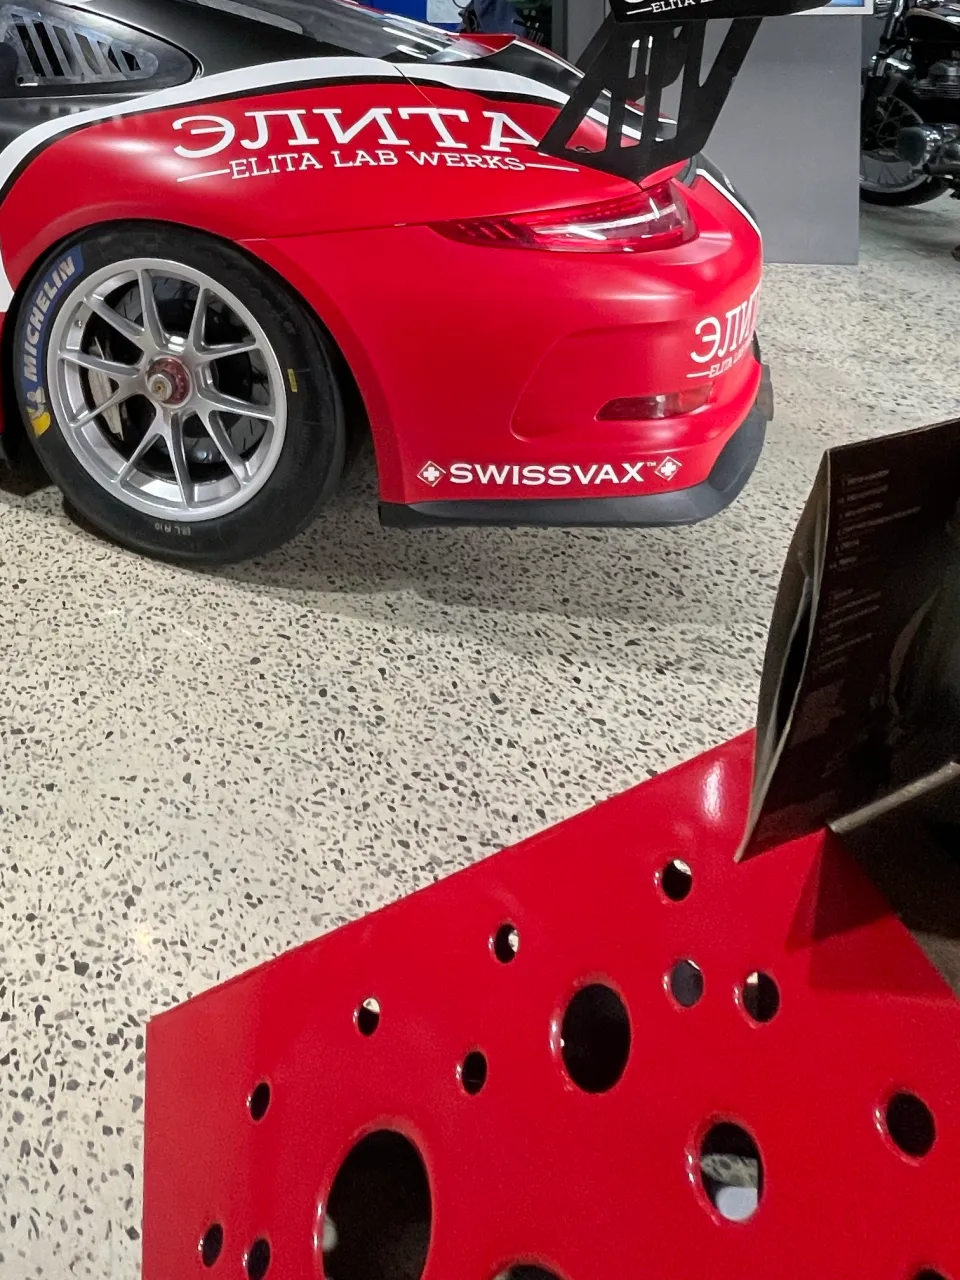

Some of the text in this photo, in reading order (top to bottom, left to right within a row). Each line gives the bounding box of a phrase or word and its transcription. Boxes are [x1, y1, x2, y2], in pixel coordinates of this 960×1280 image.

[173, 107, 538, 159] ЭЛИТА
[230, 150, 526, 179] ELITA LAB WERKS
[24, 253, 76, 382] MICHELIN
